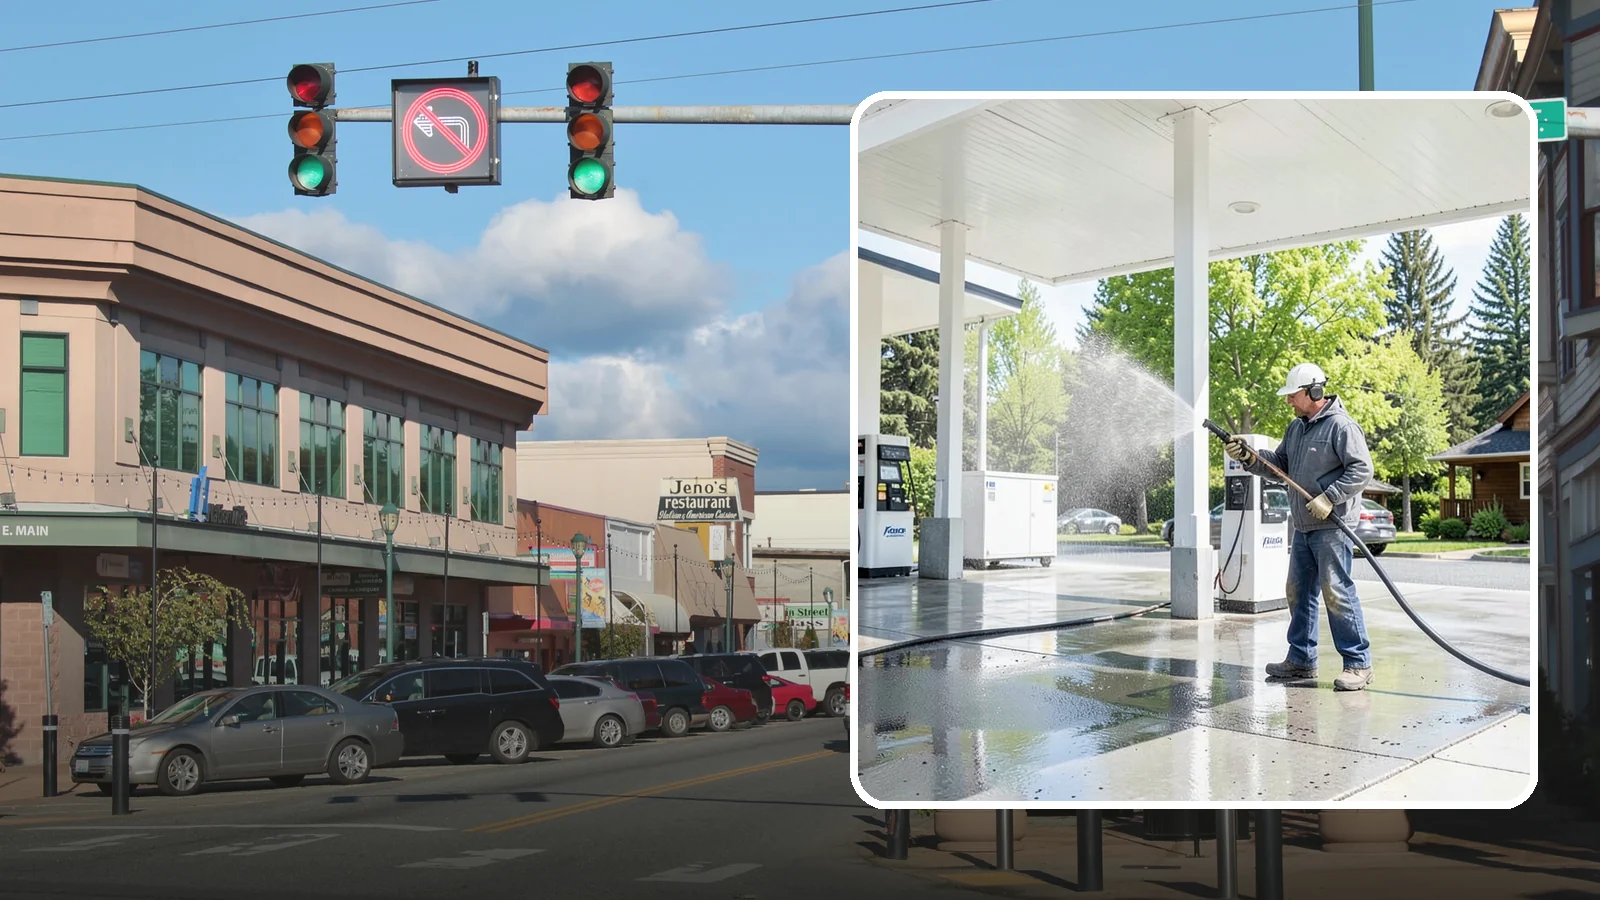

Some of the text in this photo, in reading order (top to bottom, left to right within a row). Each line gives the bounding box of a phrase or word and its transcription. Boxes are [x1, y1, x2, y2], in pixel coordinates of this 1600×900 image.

[669, 480, 728, 495] Jeno's
[665, 496, 731, 509] restaurant
[658, 510, 681, 519] Italian
[686, 510, 714, 519] American
[715, 509, 737, 519] Cuisine
[2, 525, 49, 536] E. MAIN
[786, 607, 829, 617] in Street
[790, 619, 824, 627] lass
